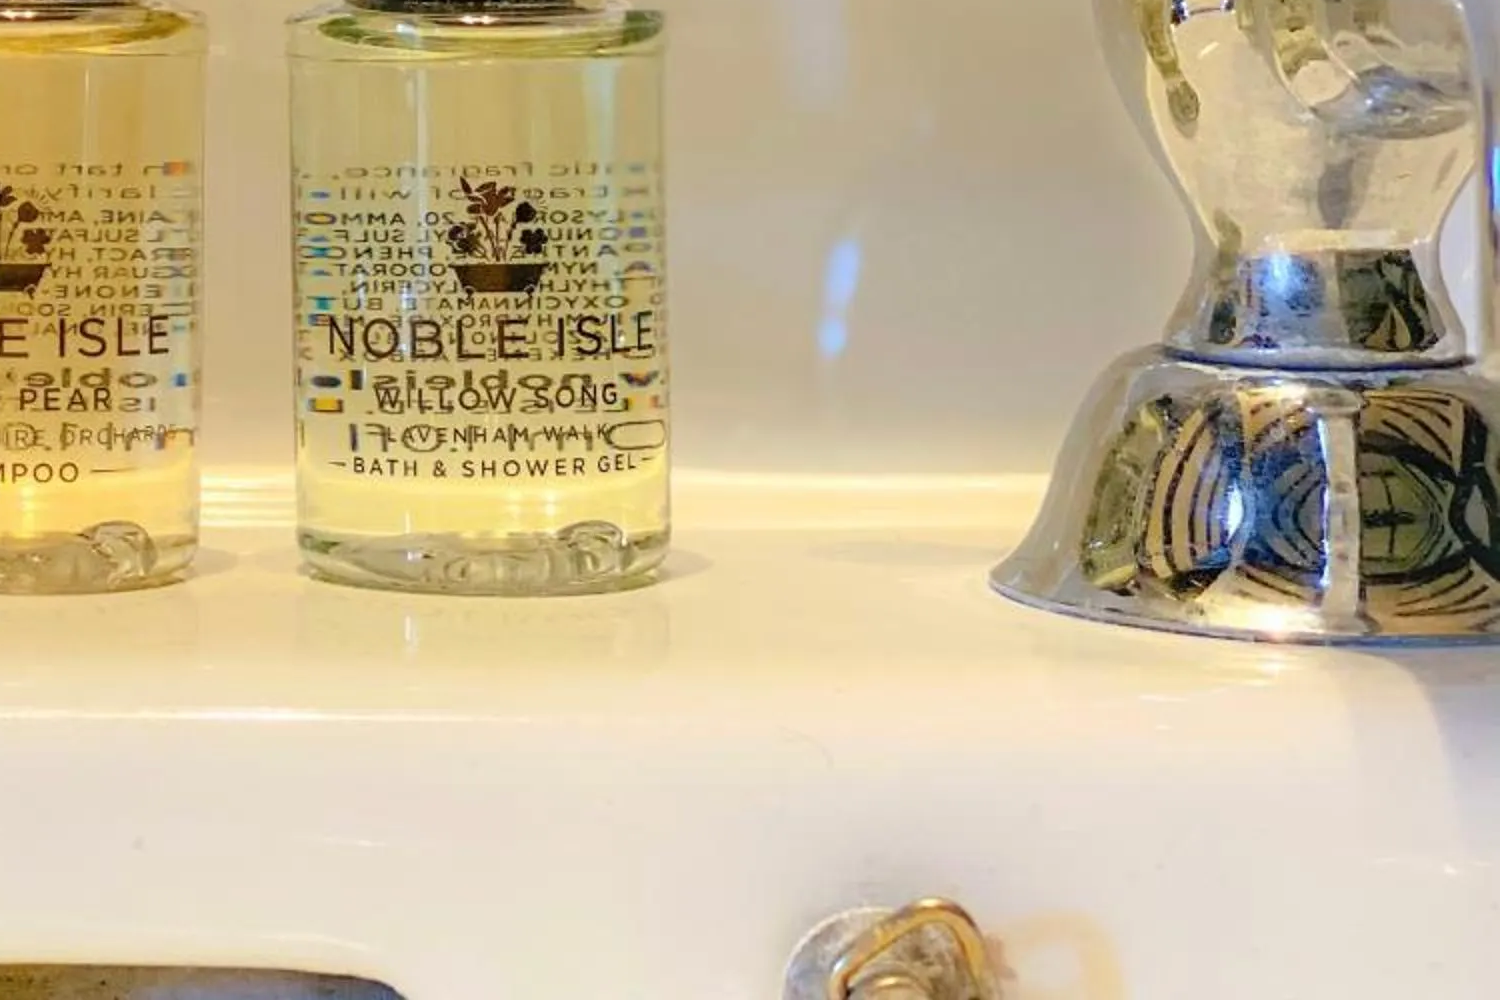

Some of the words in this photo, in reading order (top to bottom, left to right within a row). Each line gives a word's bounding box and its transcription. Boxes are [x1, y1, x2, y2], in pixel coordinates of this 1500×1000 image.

[58, 314, 170, 358] ISLE
[328, 314, 530, 360] NOBLE
[556, 310, 654, 358] ISLE
[19, 386, 113, 411] PEAR
[375, 384, 516, 411] WILLOW
[534, 383, 618, 410] SONG
[386, 425, 529, 444] LAVENHAM
[353, 457, 418, 477] BATH
[432, 460, 448, 477] &
[462, 457, 586, 478] SHOWER
[597, 453, 638, 473] GEL
